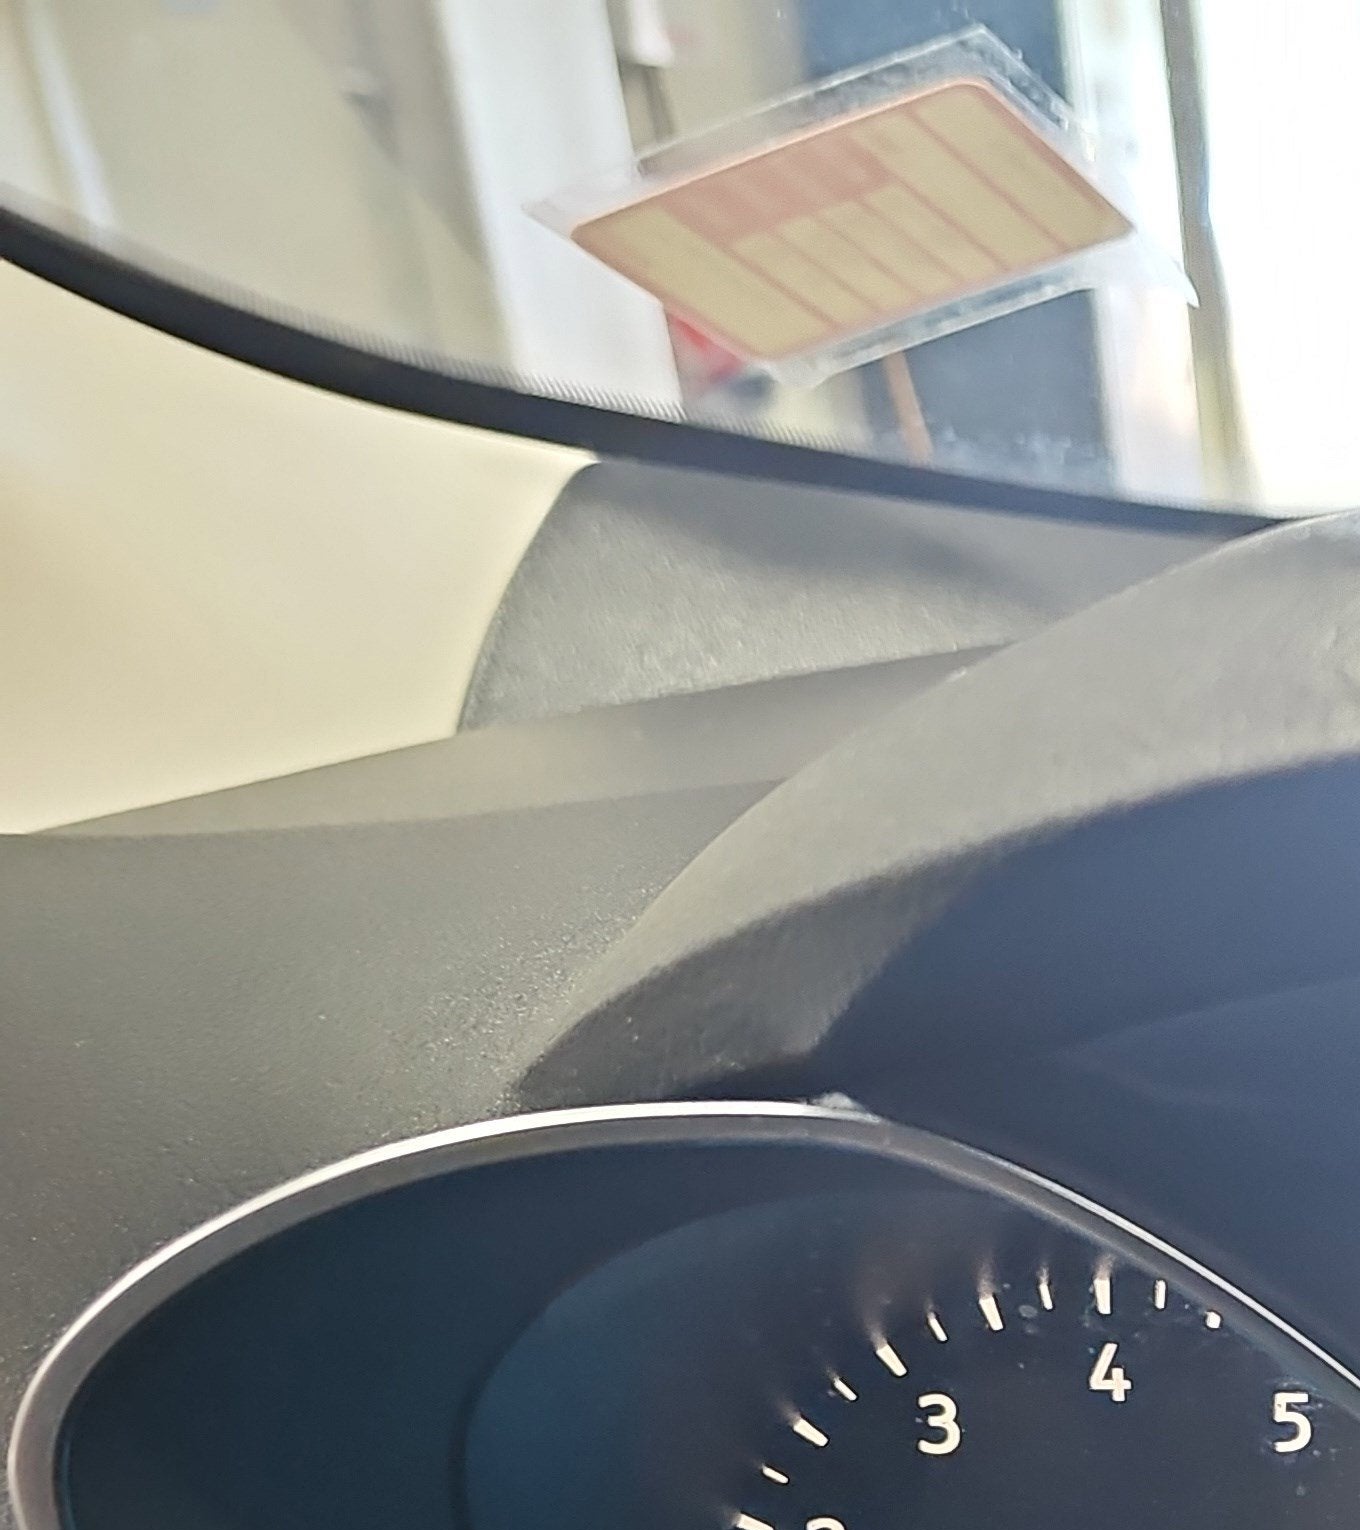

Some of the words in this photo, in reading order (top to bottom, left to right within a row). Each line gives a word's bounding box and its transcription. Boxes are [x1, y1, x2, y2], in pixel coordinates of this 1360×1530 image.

[1090, 1343, 1131, 1402] 4
[919, 1393, 961, 1455] 3
[1273, 1392, 1311, 1452] 5
